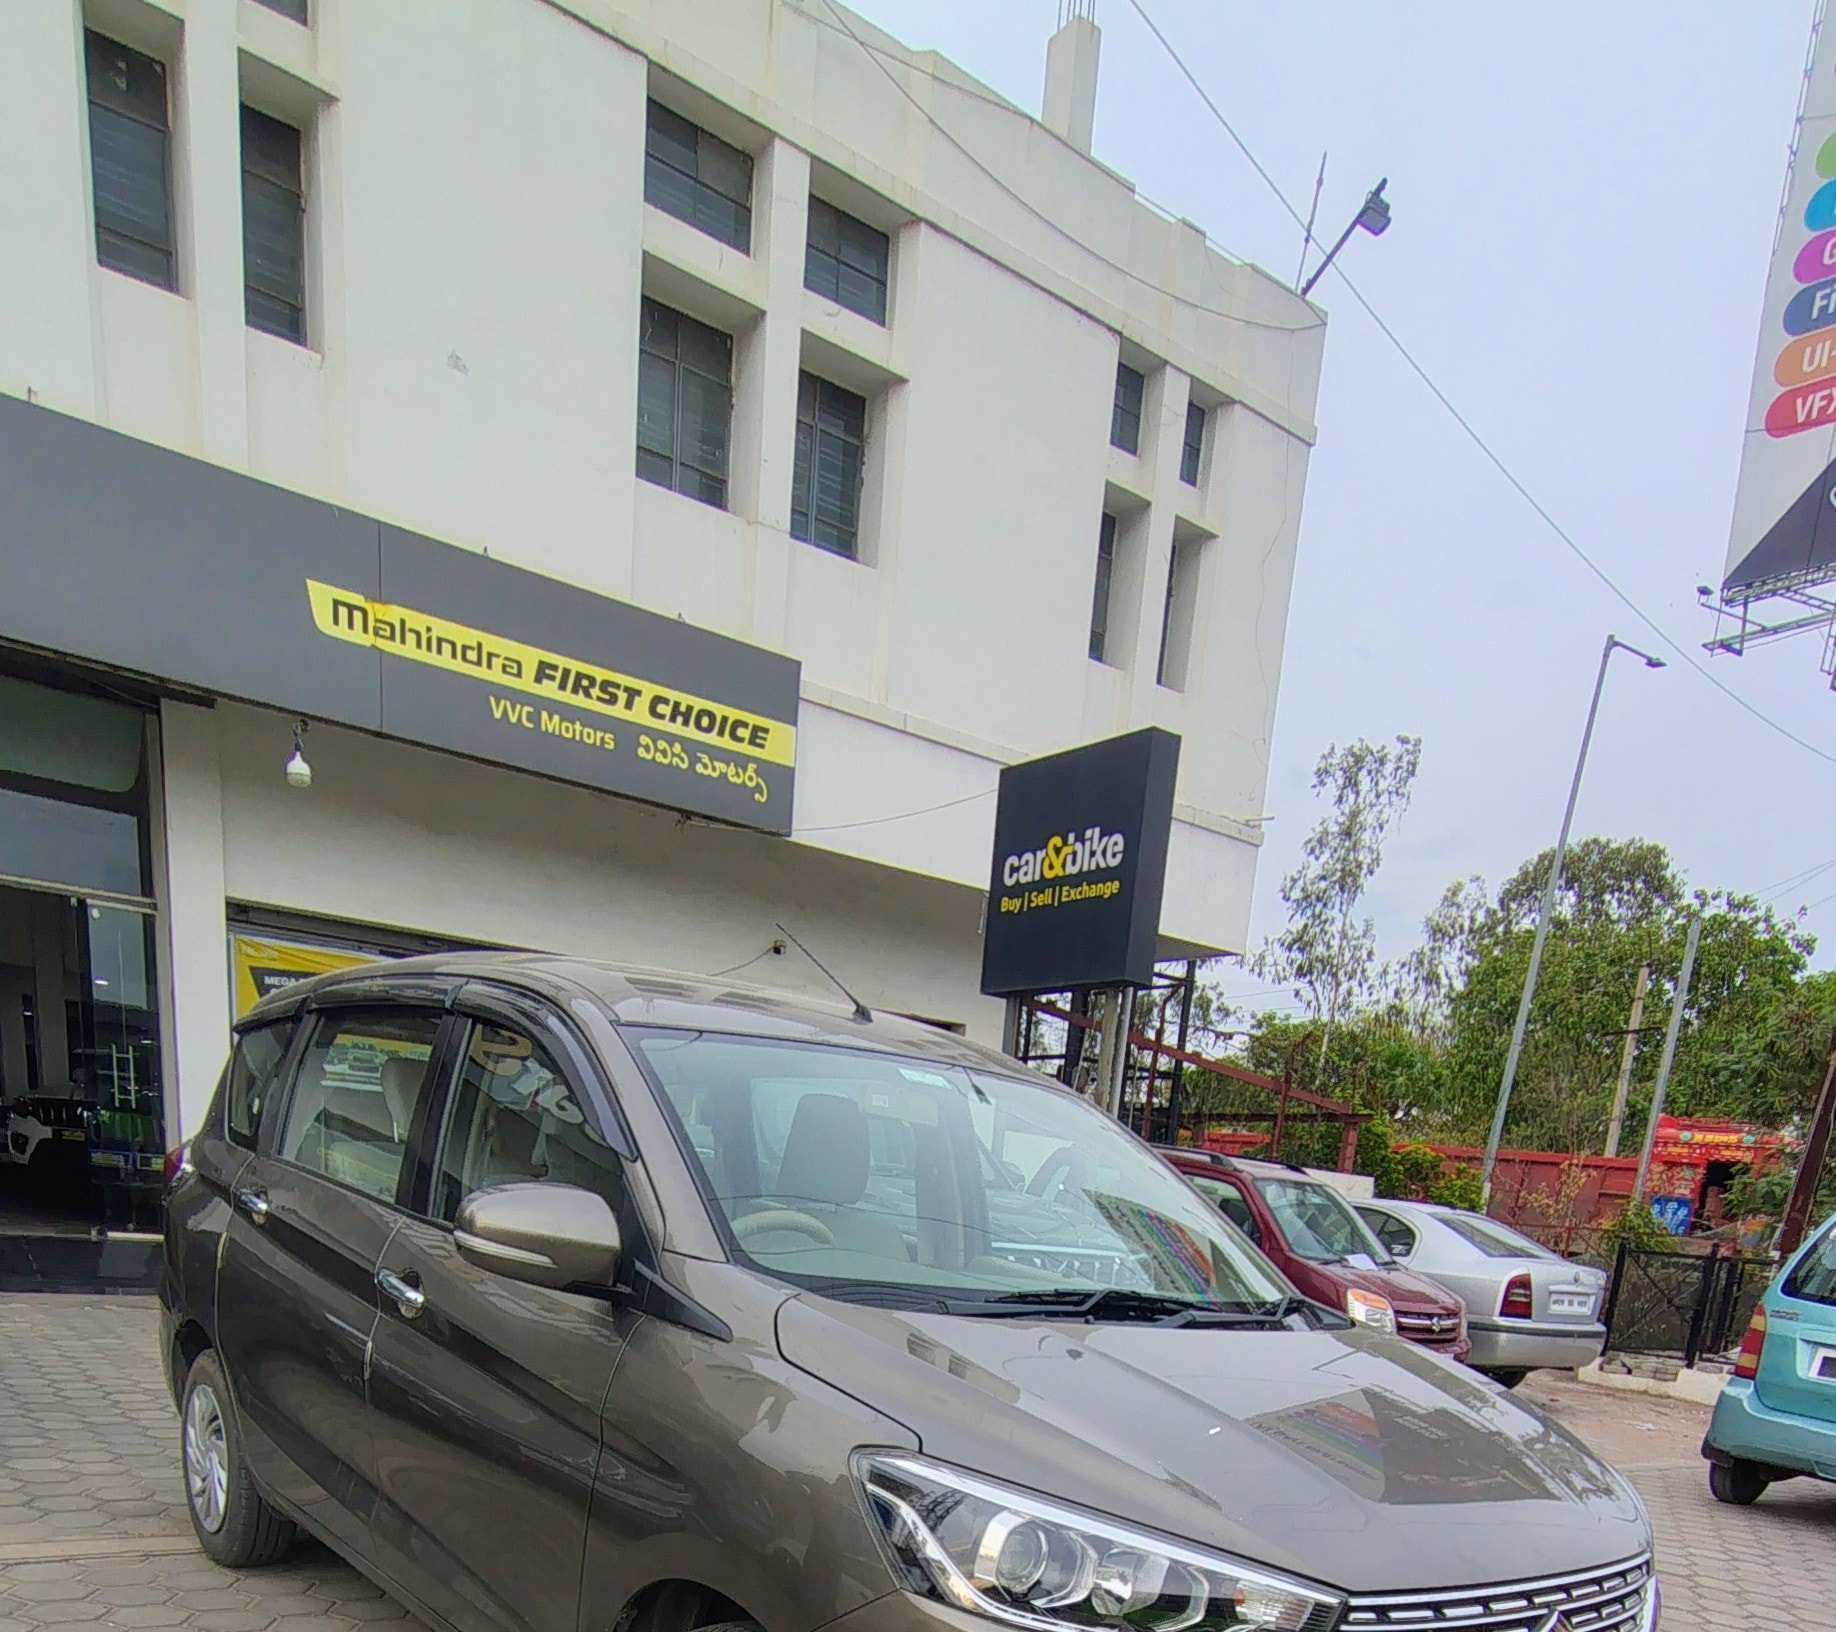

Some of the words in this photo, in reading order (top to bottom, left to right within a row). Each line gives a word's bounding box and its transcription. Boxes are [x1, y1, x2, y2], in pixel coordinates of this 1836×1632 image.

[489, 695, 534, 728] VVC
[540, 710, 615, 750] Motors
[533, 659, 643, 712] FIRST
[648, 694, 770, 750] CHOICE
[1003, 826, 1125, 887] car&bike
[1001, 896, 1022, 914] Buy
[1030, 887, 1053, 908] Sell
[1061, 880, 1121, 902] Exchange
